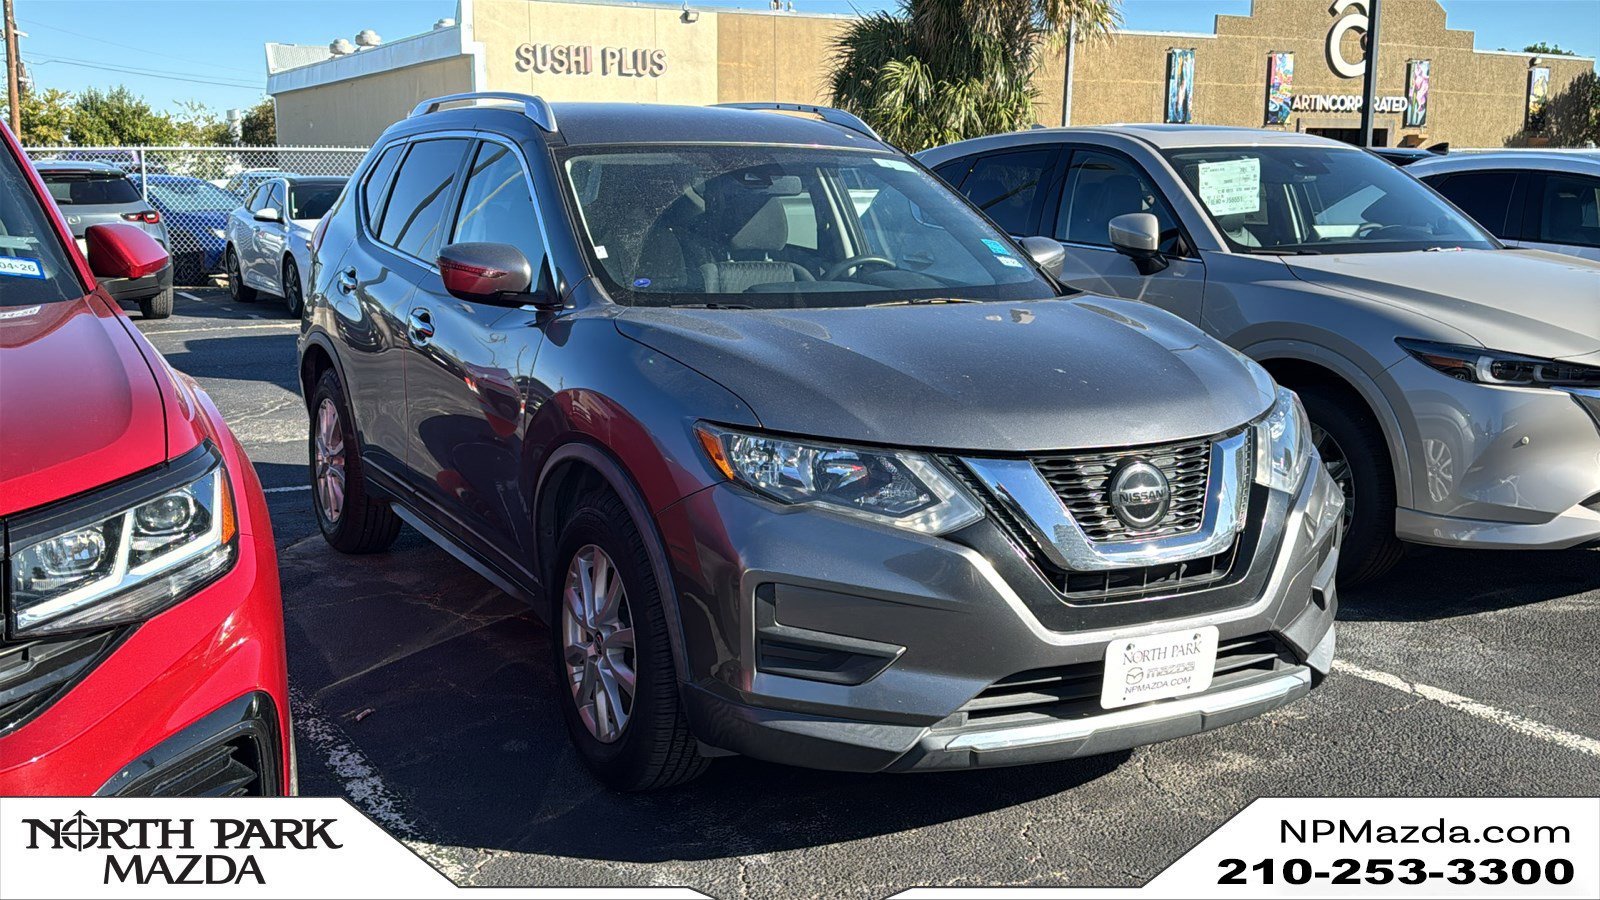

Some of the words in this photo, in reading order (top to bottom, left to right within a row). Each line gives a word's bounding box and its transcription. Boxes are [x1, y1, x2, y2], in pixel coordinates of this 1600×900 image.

[515, 43, 592, 75] SUSHI
[601, 46, 668, 78] PLUS
[1291, 94, 1409, 113] ARTINCORPRATED
[1119, 488, 1165, 503] NISSAN
[1122, 645, 1167, 665] NORTH
[1171, 640, 1202, 658] PARK
